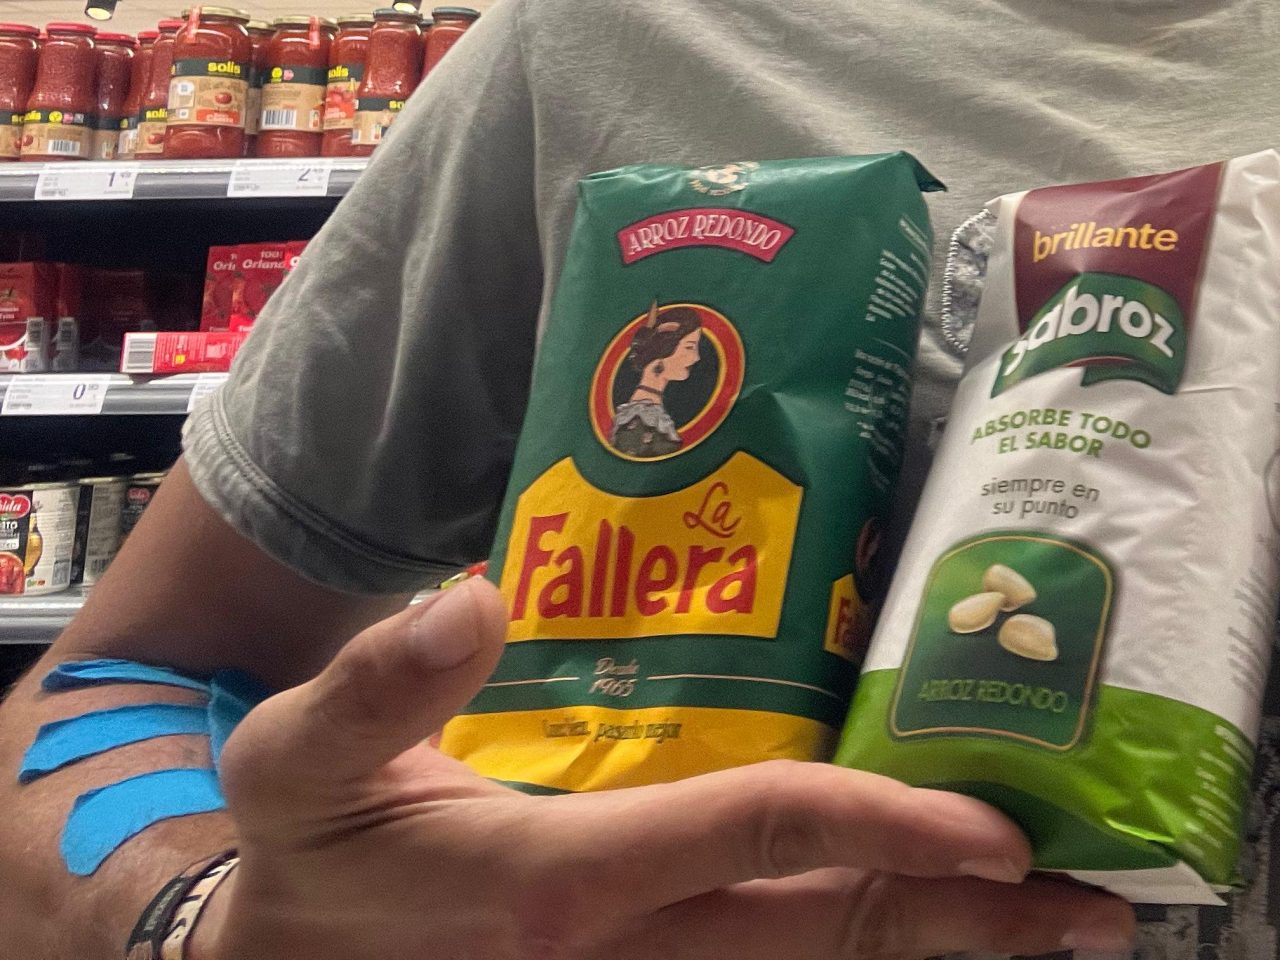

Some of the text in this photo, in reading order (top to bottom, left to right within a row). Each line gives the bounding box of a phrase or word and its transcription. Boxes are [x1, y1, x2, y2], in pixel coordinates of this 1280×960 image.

[207, 61, 241, 74] solis
[628, 214, 782, 255] ARROZ REDONDO
[1032, 221, 1179, 263] brillante
[971, 408, 1151, 450] ABSORBE TODO
[998, 431, 1104, 458] EL SABOR
[981, 476, 1100, 503] siempre en
[682, 481, 741, 538] La
[993, 498, 1079, 521] su punto
[510, 512, 758, 622] Fallera
[918, 679, 1068, 713] ARROZ REDONDO
